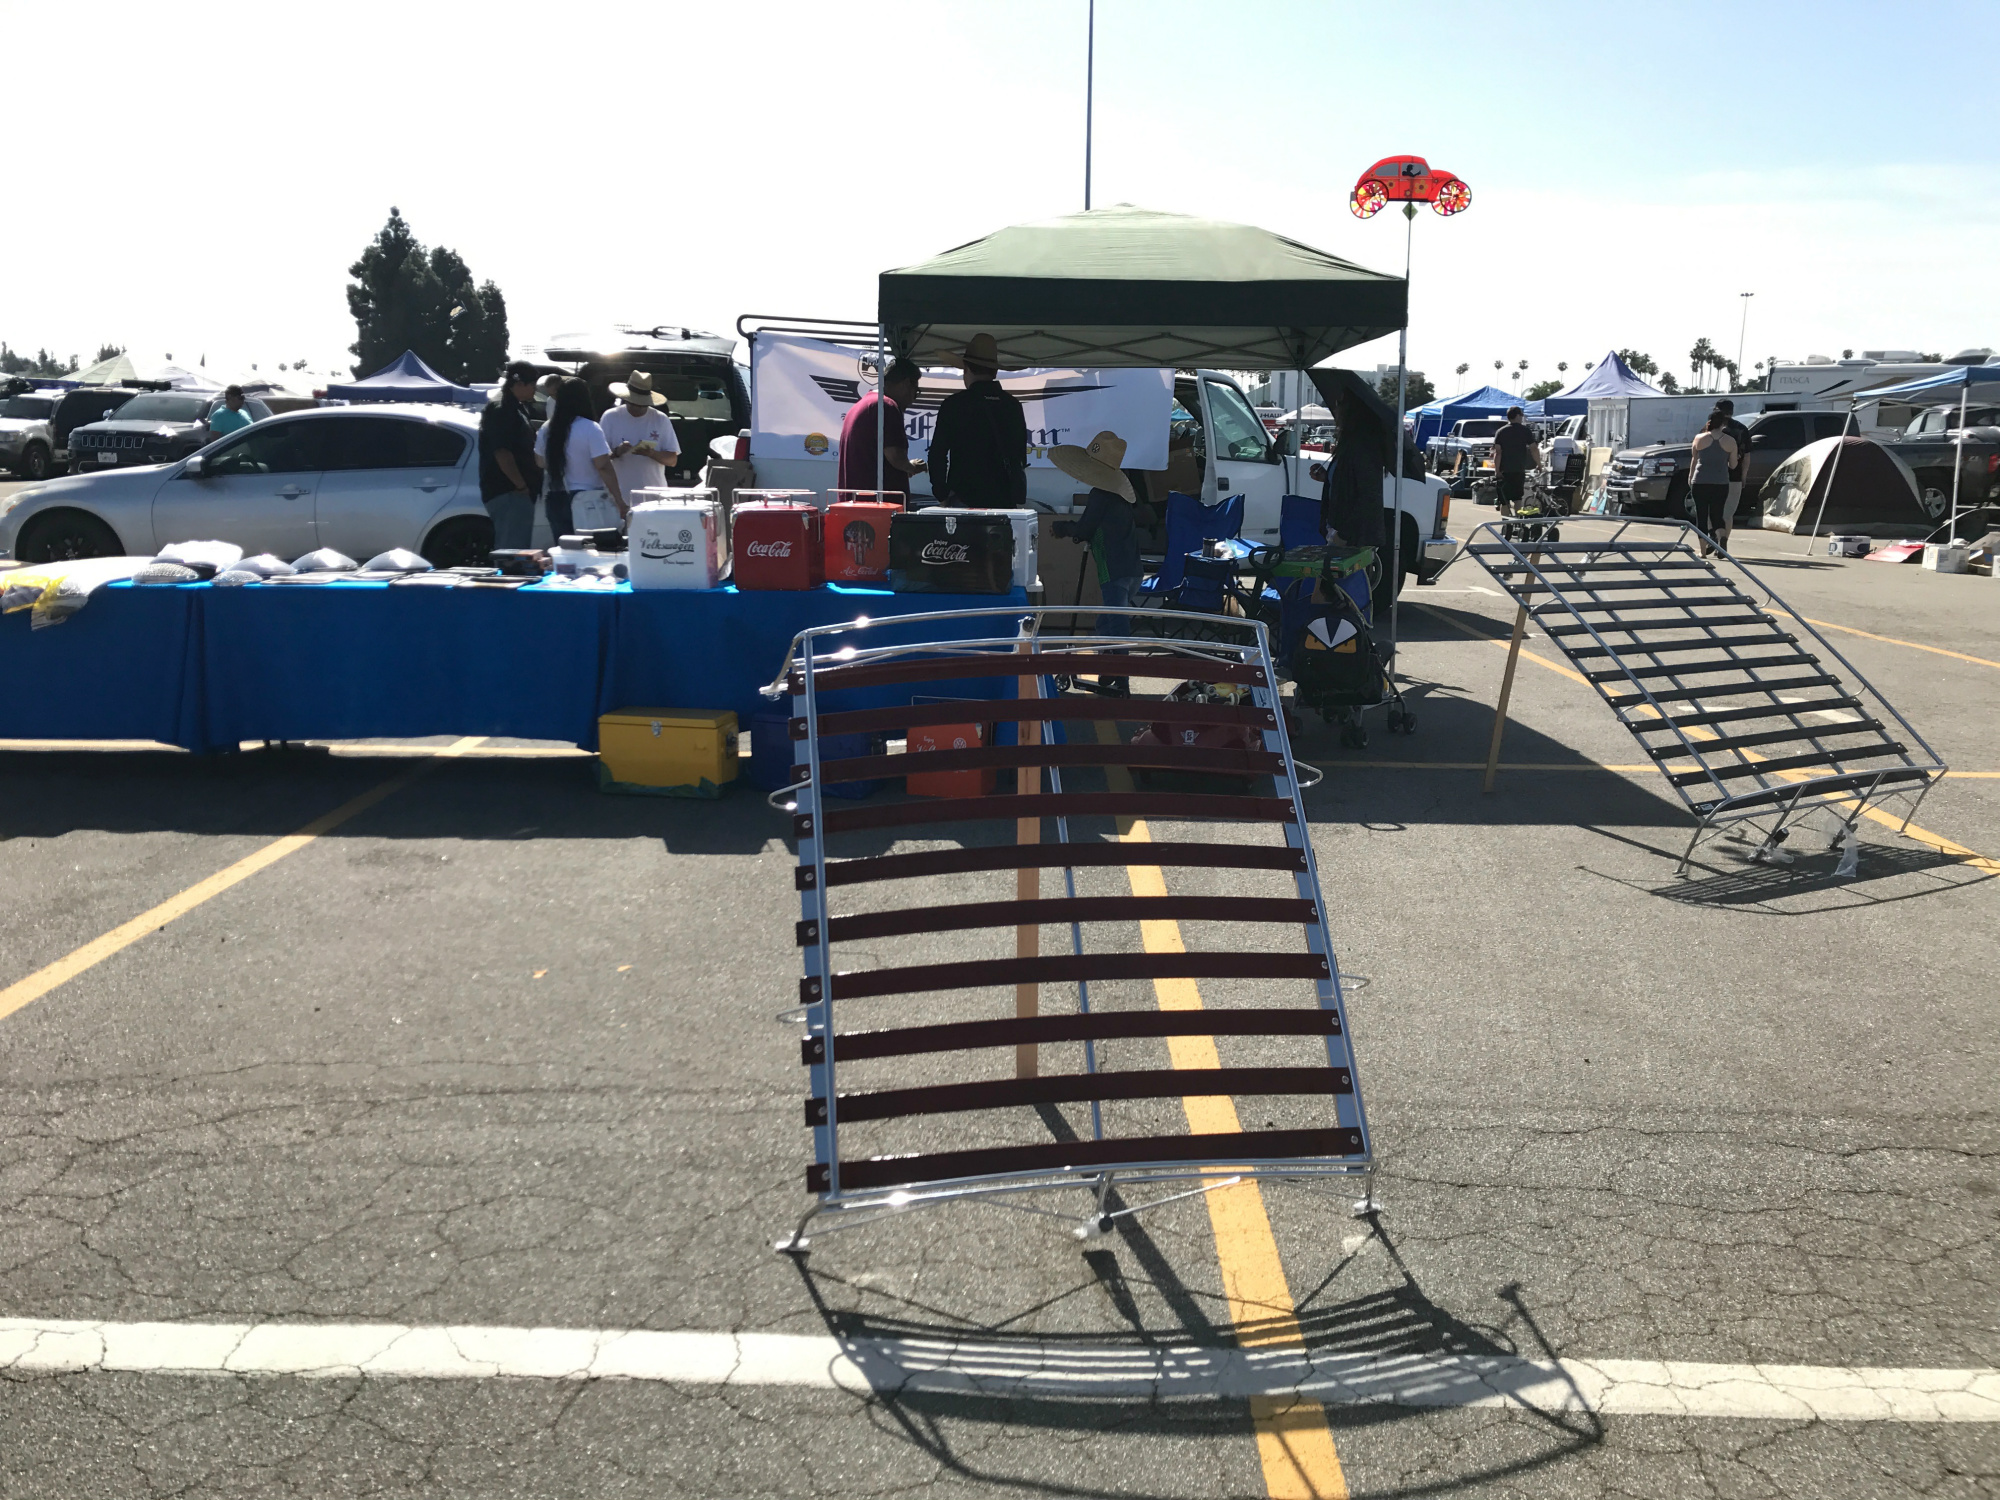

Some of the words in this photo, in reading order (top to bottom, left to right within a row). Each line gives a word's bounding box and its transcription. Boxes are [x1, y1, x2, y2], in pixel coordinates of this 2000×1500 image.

[1780, 376, 1810, 384] ITASCA
[746, 540, 793, 557] Coca-Cola
[921, 542, 970, 560] Coca-Cola
